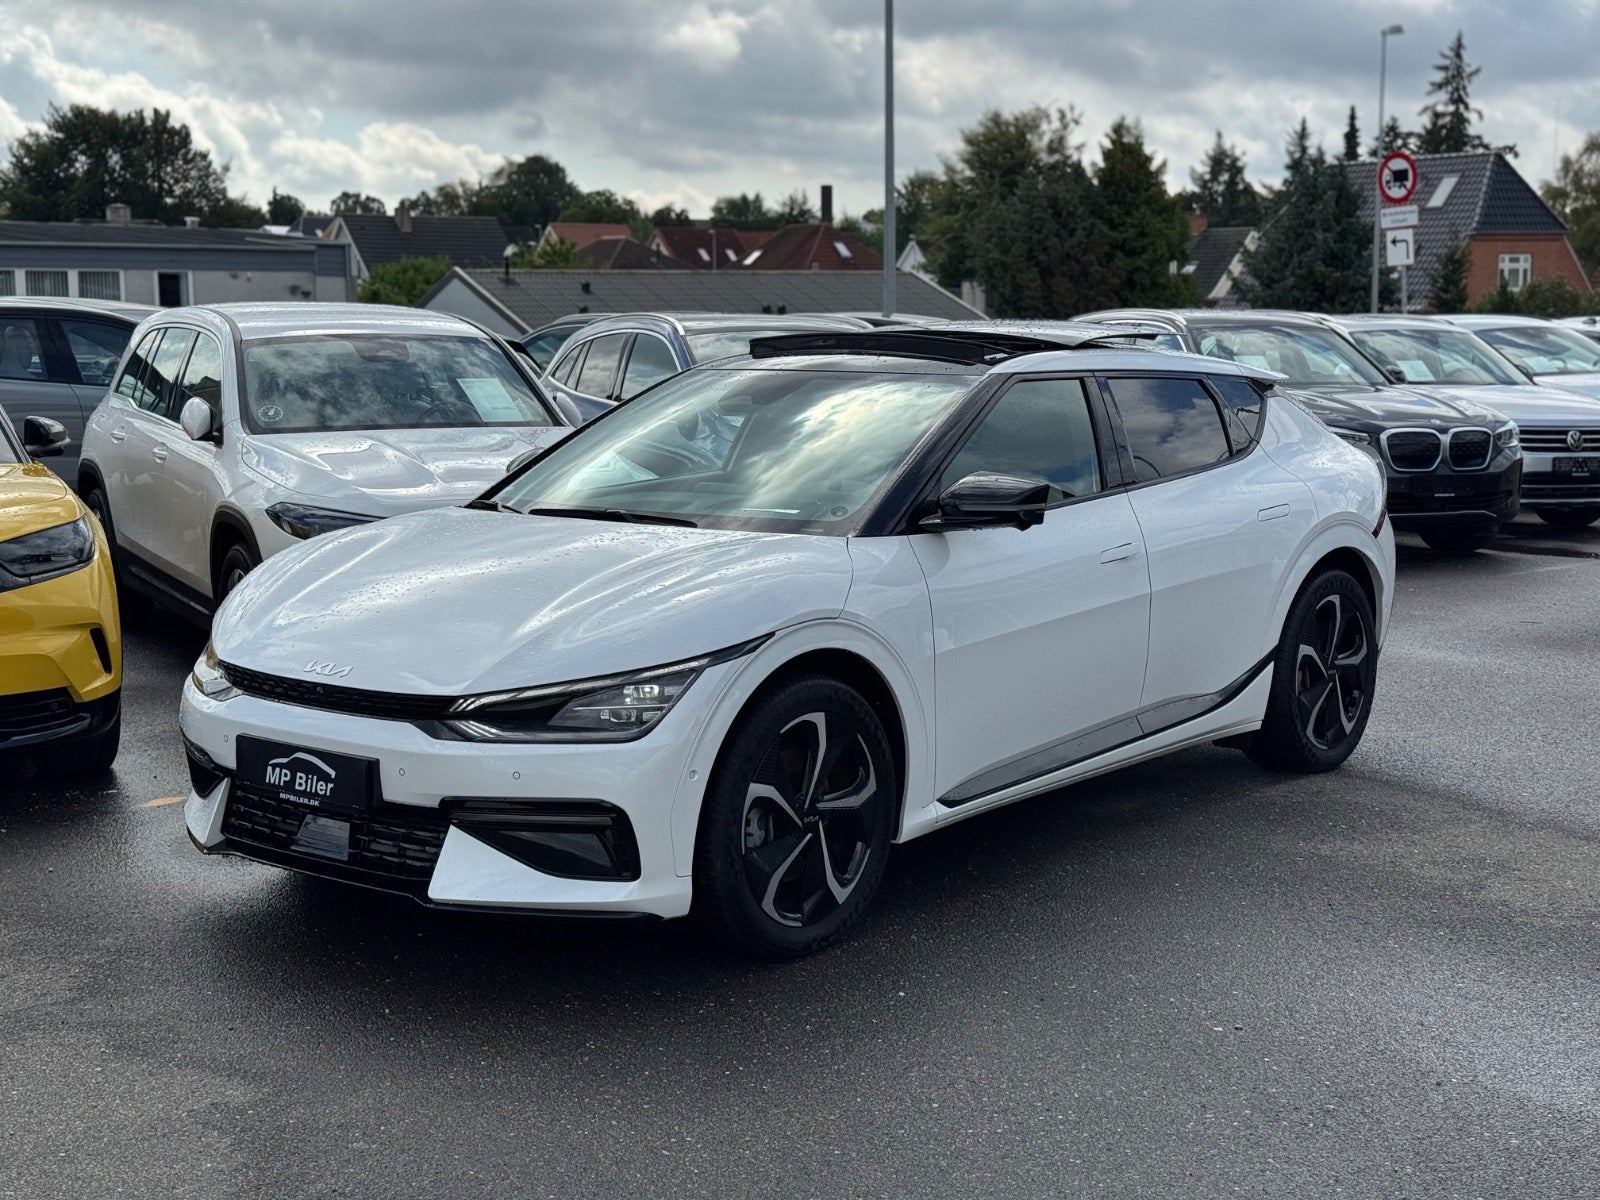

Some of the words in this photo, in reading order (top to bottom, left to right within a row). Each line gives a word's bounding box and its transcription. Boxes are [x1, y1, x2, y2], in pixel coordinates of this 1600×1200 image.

[303, 660, 354, 679] KIA
[265, 765, 291, 786] MP
[295, 771, 334, 796] Biler
[279, 792, 320, 807] MPBILER.DK
